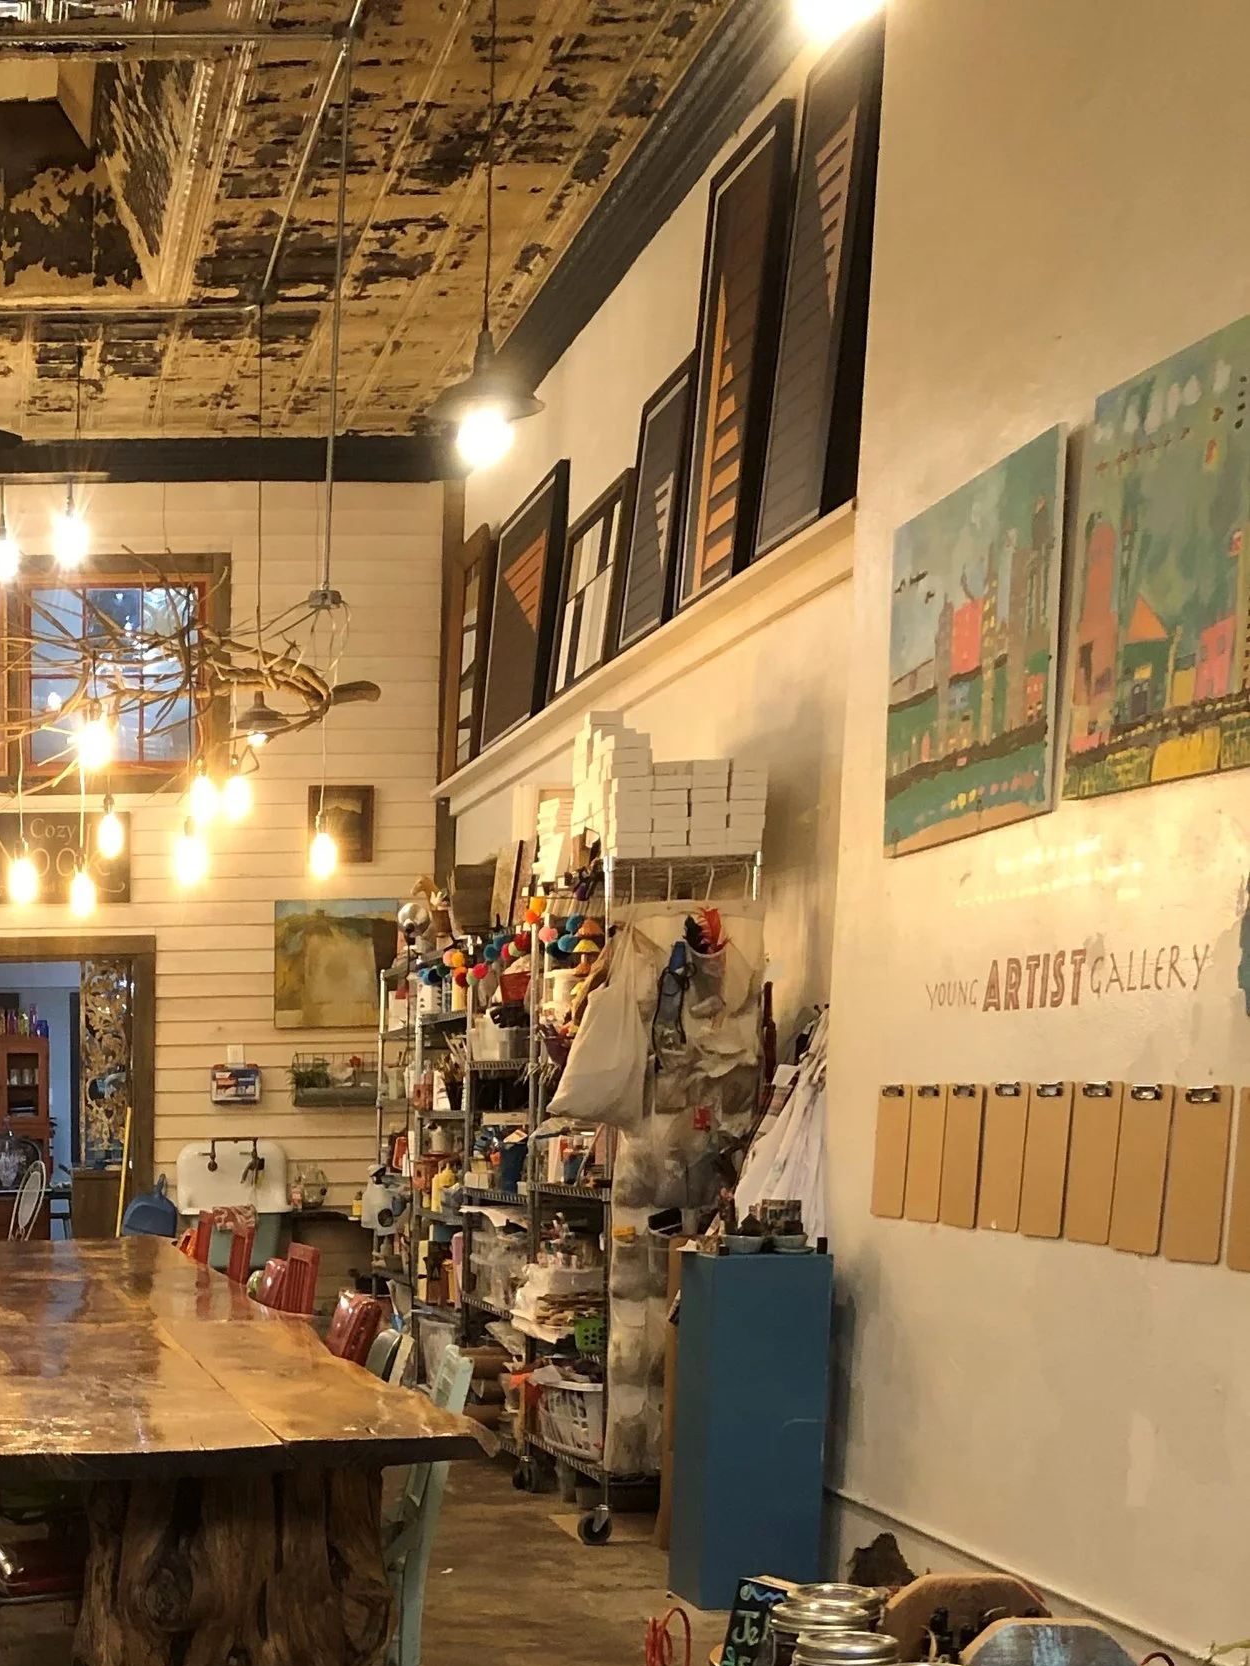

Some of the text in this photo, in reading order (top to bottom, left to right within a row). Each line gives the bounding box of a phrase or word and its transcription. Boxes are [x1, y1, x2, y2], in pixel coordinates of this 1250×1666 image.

[30, 818, 76, 845] Cozy
[926, 943, 1210, 1012] YOUNG ARTIST GALLERY
